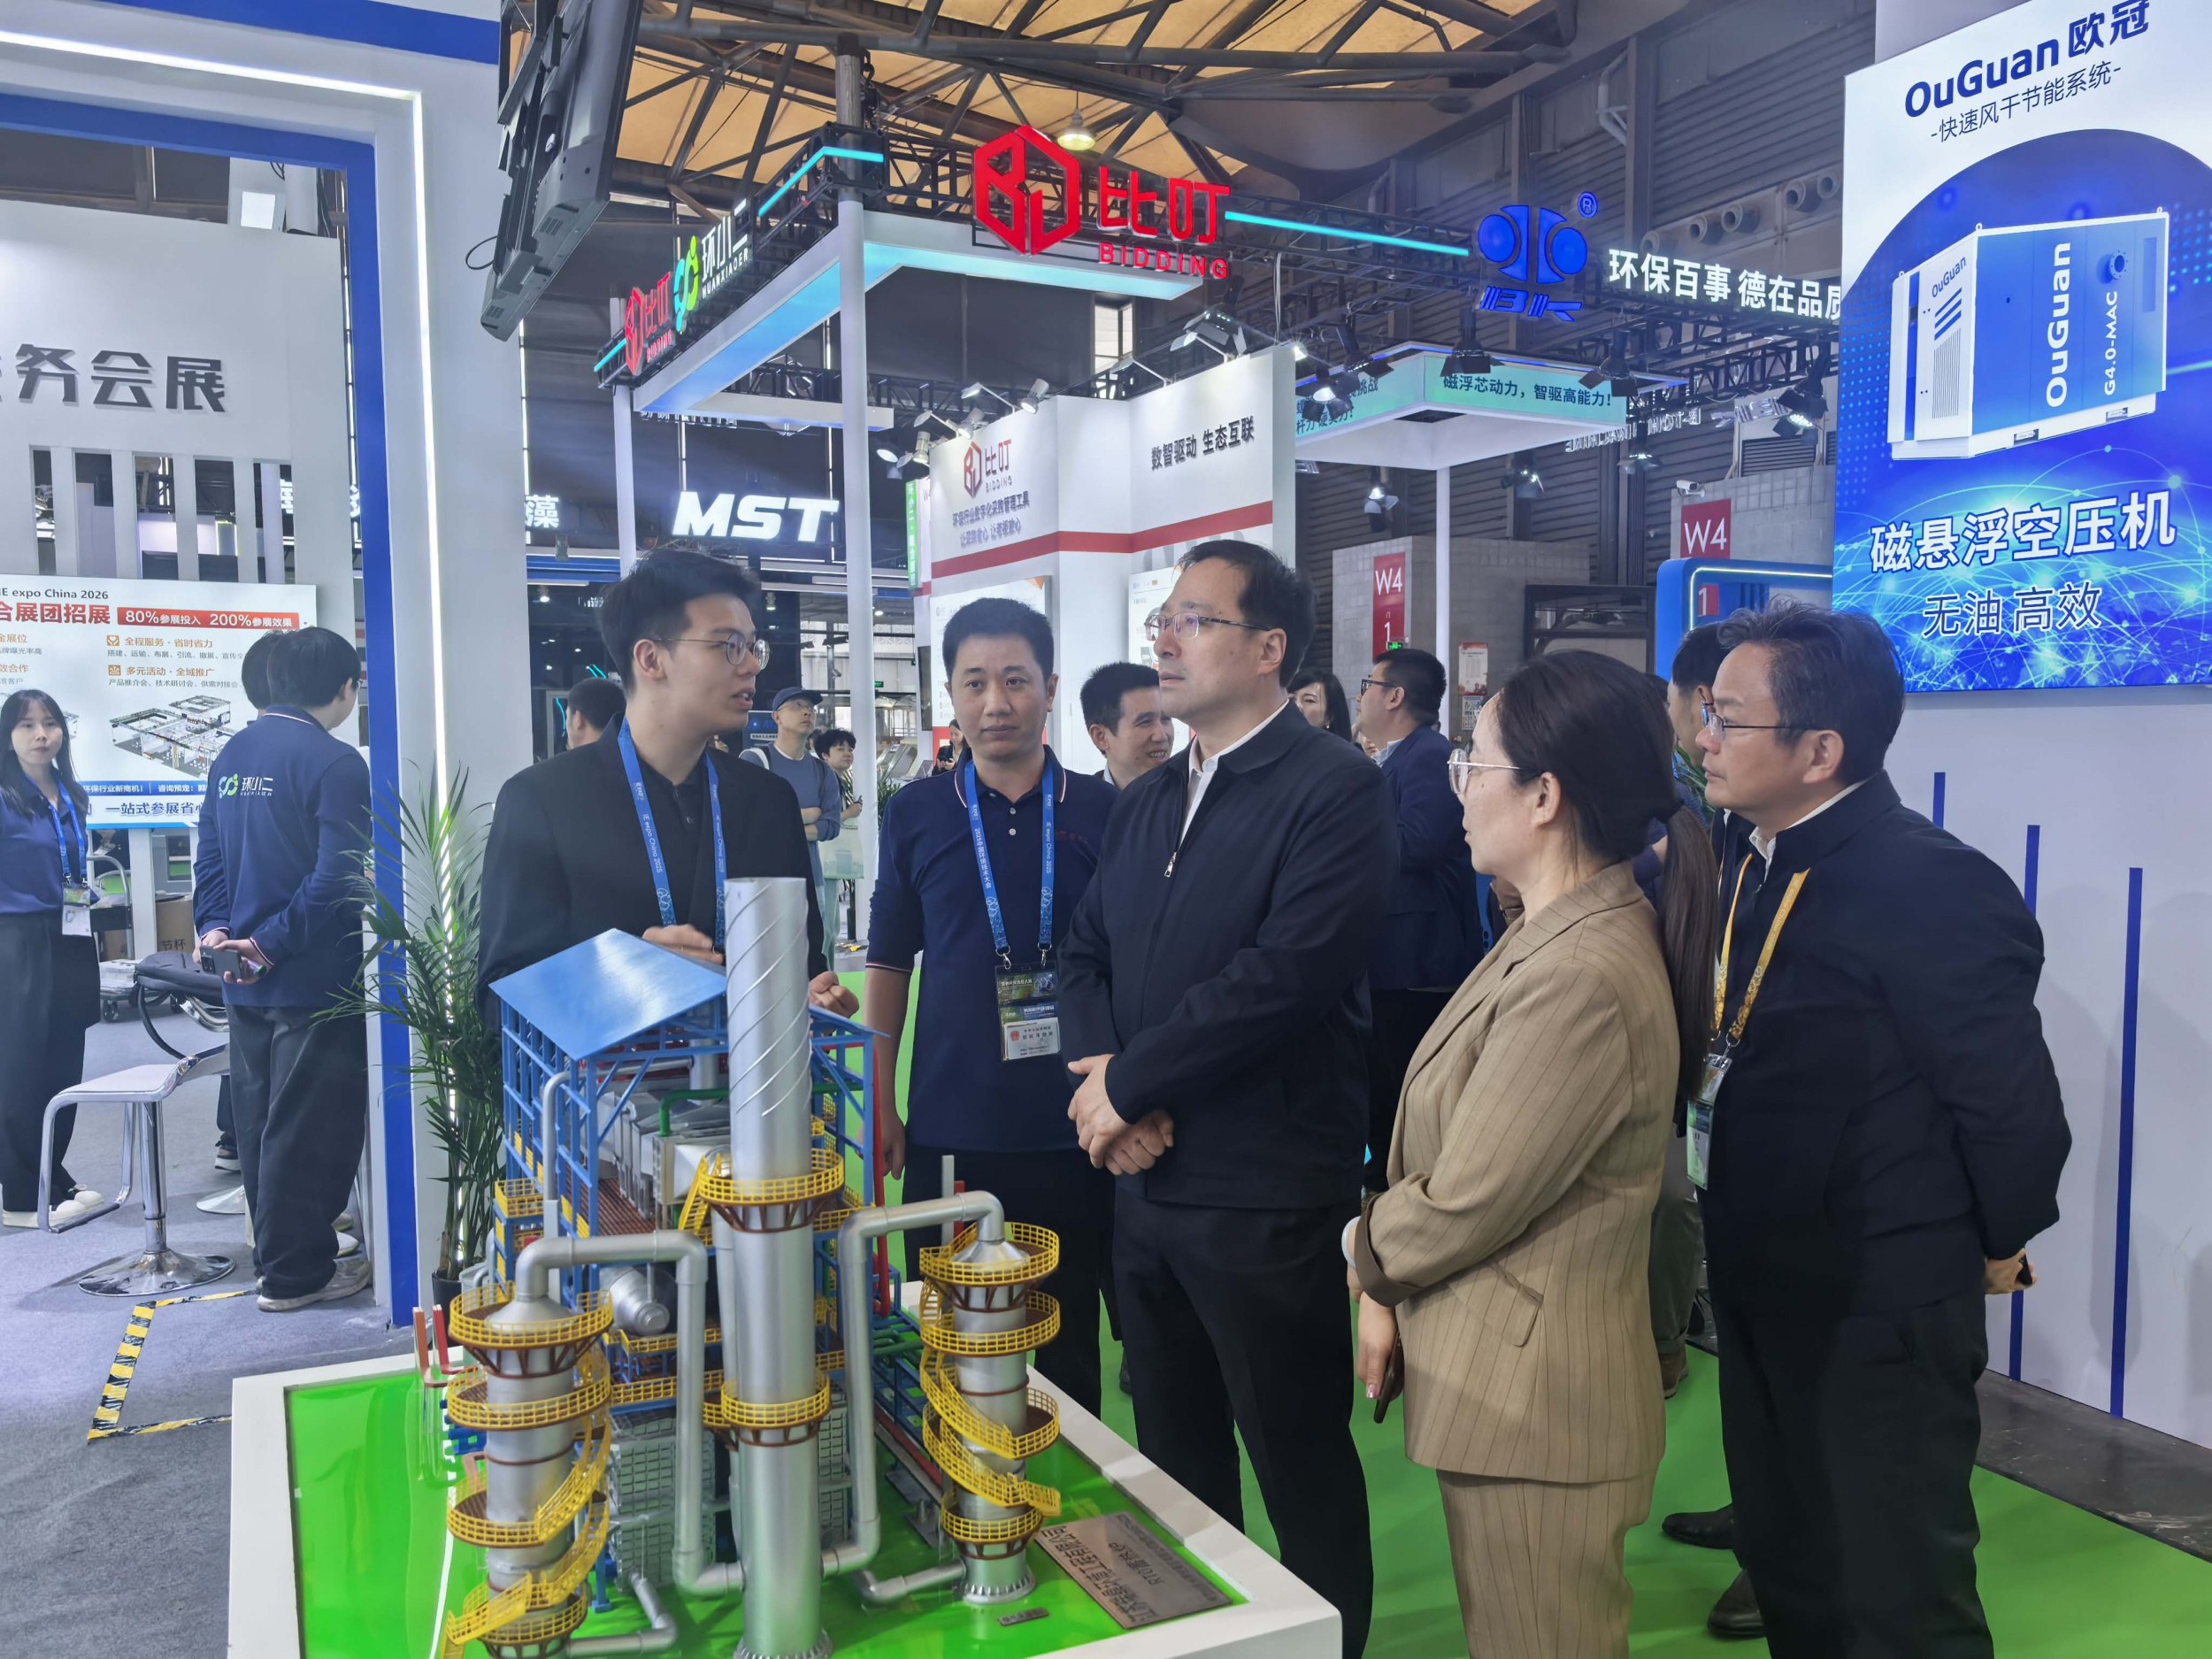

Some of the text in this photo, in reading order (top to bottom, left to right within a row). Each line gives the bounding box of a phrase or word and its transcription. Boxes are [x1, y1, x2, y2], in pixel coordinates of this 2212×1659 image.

[1904, 0, 2149, 118] OuGuan 欧冠
[703, 248, 748, 299] HUANXIAOER
[1099, 242, 1228, 279] BIDDING
[1609, 249, 1732, 303] 环保百事
[1932, 256, 1967, 298] OuGuan
[2046, 242, 2071, 408] OuGuan
[2104, 291, 2118, 396] G4.0-MAC
[0, 343, 225, 412] 务会展
[1151, 416, 1255, 471] 数智驱动 生态互联
[672, 491, 840, 542] MST
[1685, 518, 1726, 554] W4
[1870, 490, 2177, 572] 磁悬浮空压机
[12, 589, 41, 599] expo
[44, 588, 77, 599] China
[81, 590, 109, 600] 2026
[1375, 566, 1402, 595] W4
[125, 611, 293, 627] 80%参展投入 200%参展效果
[1922, 580, 2102, 639] 无油 高效
